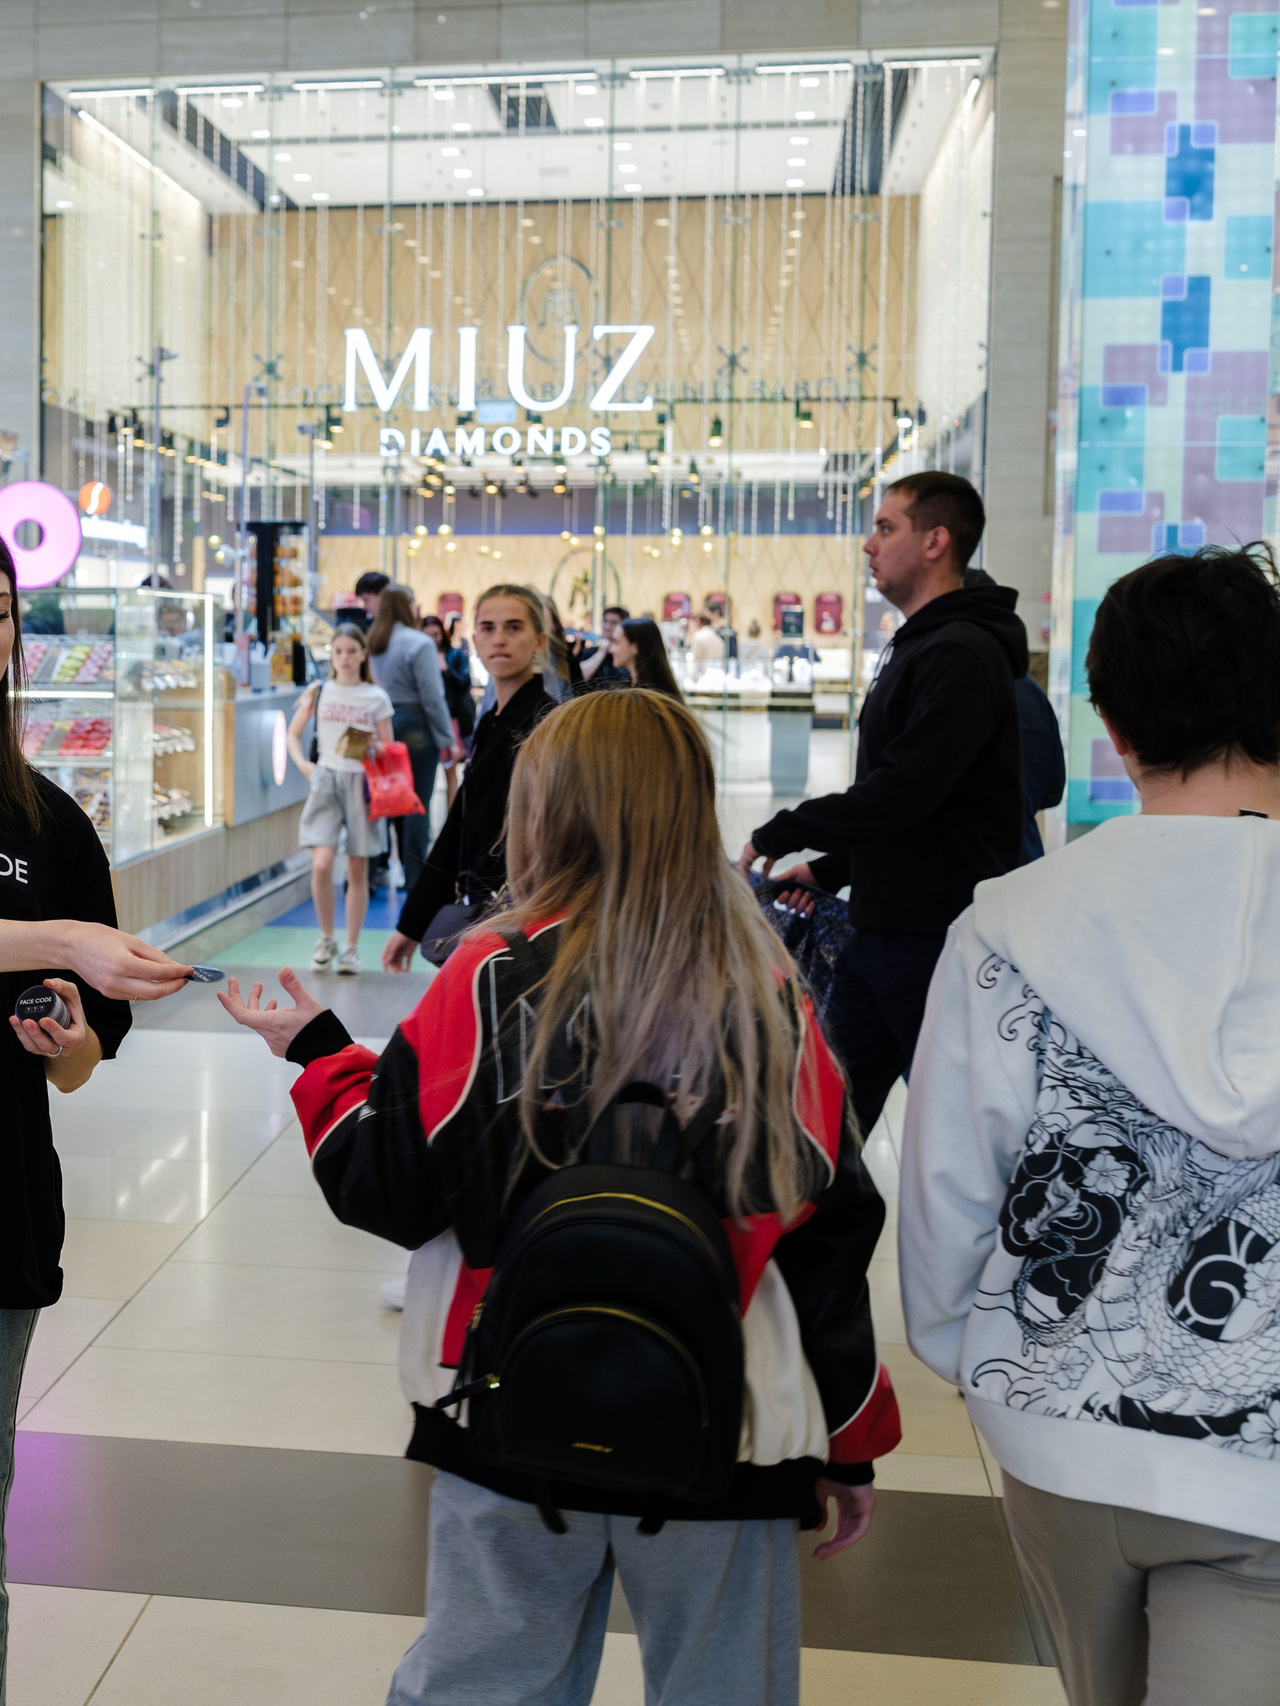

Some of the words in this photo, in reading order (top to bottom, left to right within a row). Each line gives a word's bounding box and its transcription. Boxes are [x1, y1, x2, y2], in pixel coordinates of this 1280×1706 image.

[342, 324, 656, 413] MIUZ
[379, 426, 612, 457] DIAMONDS
[35, 996, 52, 1004] CODE
